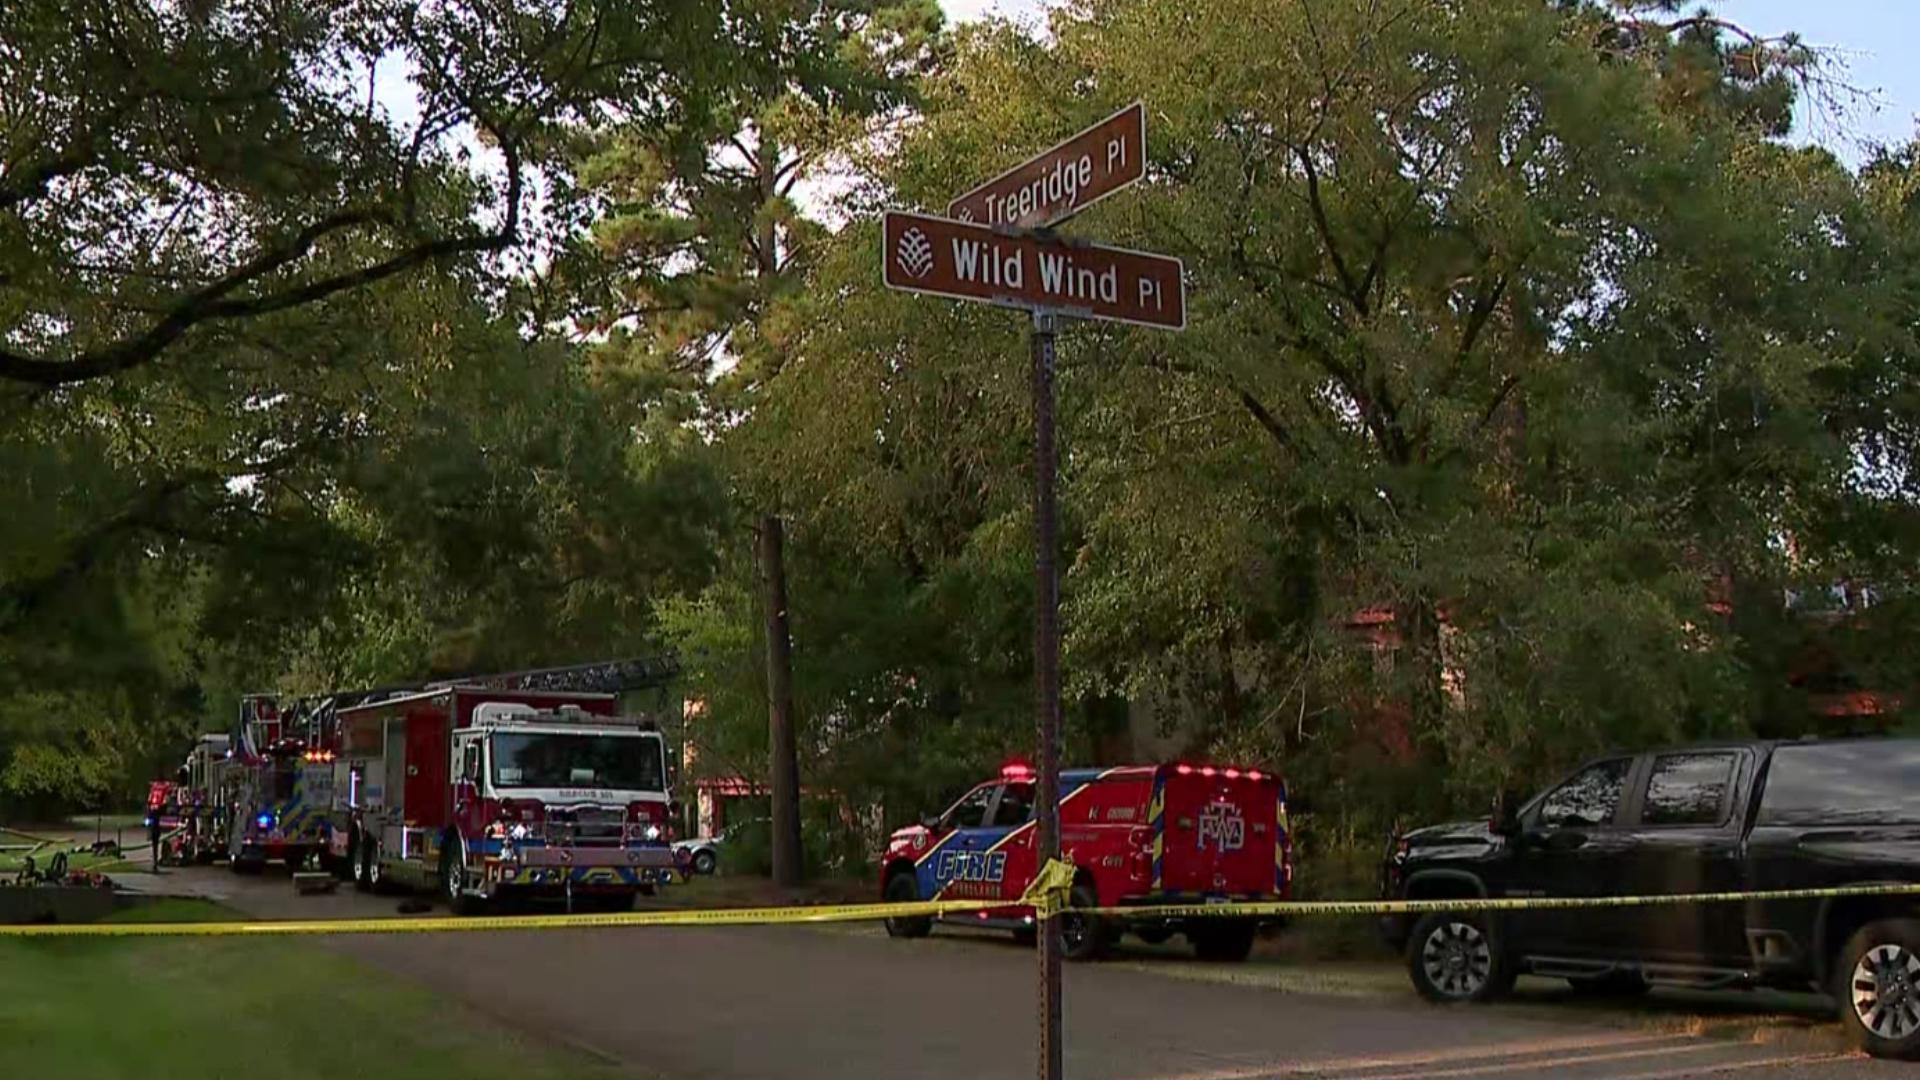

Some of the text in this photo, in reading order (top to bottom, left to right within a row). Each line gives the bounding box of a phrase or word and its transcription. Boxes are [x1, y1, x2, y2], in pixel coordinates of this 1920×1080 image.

[985, 154, 1092, 224] Treeridge
[952, 237, 1023, 289] Wild
[1038, 252, 1117, 304] Wind
[937, 850, 1007, 881] FIRE
